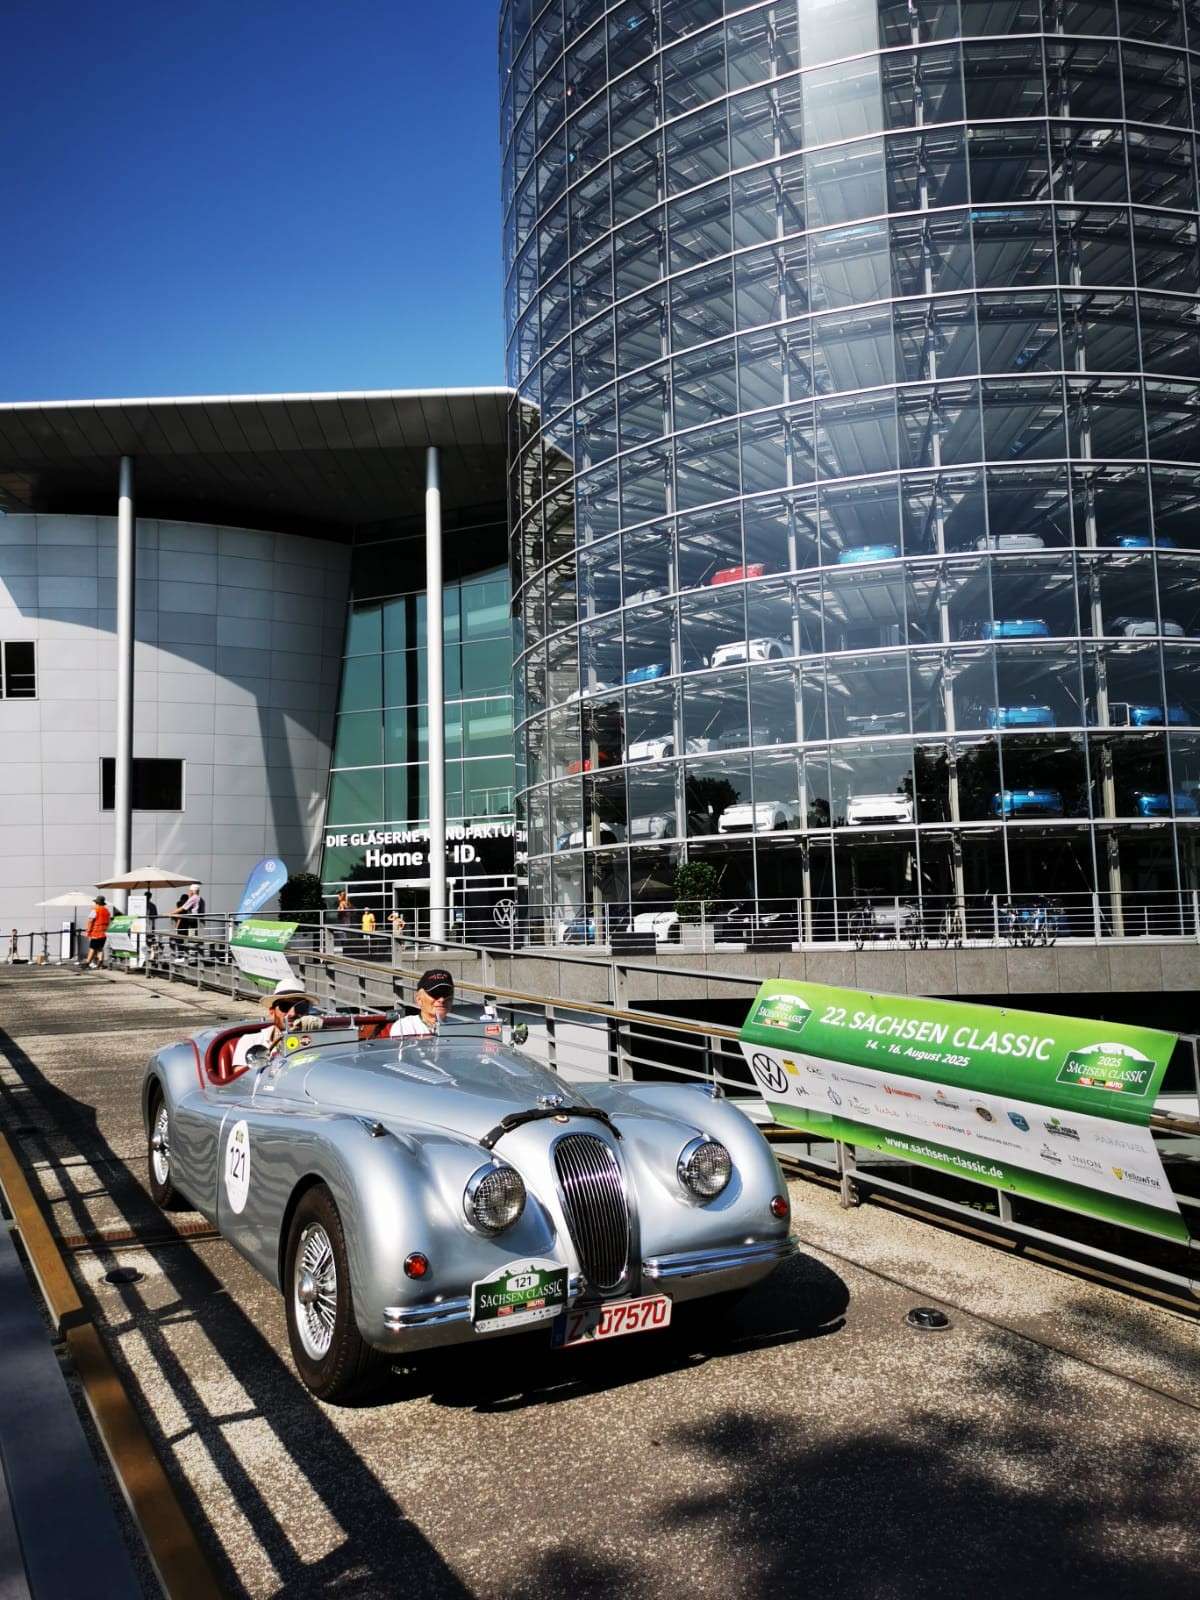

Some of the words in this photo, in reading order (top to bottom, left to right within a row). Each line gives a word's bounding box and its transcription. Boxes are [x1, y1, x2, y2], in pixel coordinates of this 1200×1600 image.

[326, 833, 348, 847] DIE
[350, 829, 420, 846] GLÄSERNE
[366, 849, 422, 868] Home
[454, 845, 481, 864] ID.
[819, 1006, 846, 1027] 22.
[848, 1011, 949, 1045] SACHSEN
[953, 1027, 1055, 1061] CLASSIC
[865, 1039, 879, 1051] 14.
[887, 1044, 901, 1056] 16.
[903, 1047, 940, 1063] August
[941, 1054, 972, 1067] 2025
[1097, 1055, 1122, 1067] 2025
[1066, 1060, 1105, 1078] SACHSEN
[1107, 1069, 1147, 1084] CLASSIC
[230, 1147, 245, 1182] 121
[885, 1136, 1004, 1179] www.sachsen-classic.de
[480, 1291, 524, 1309] SACHSEN
[526, 1279, 564, 1299] CLASSIC
[514, 1275, 532, 1289] 121
[598, 1299, 667, 1335] 07570
